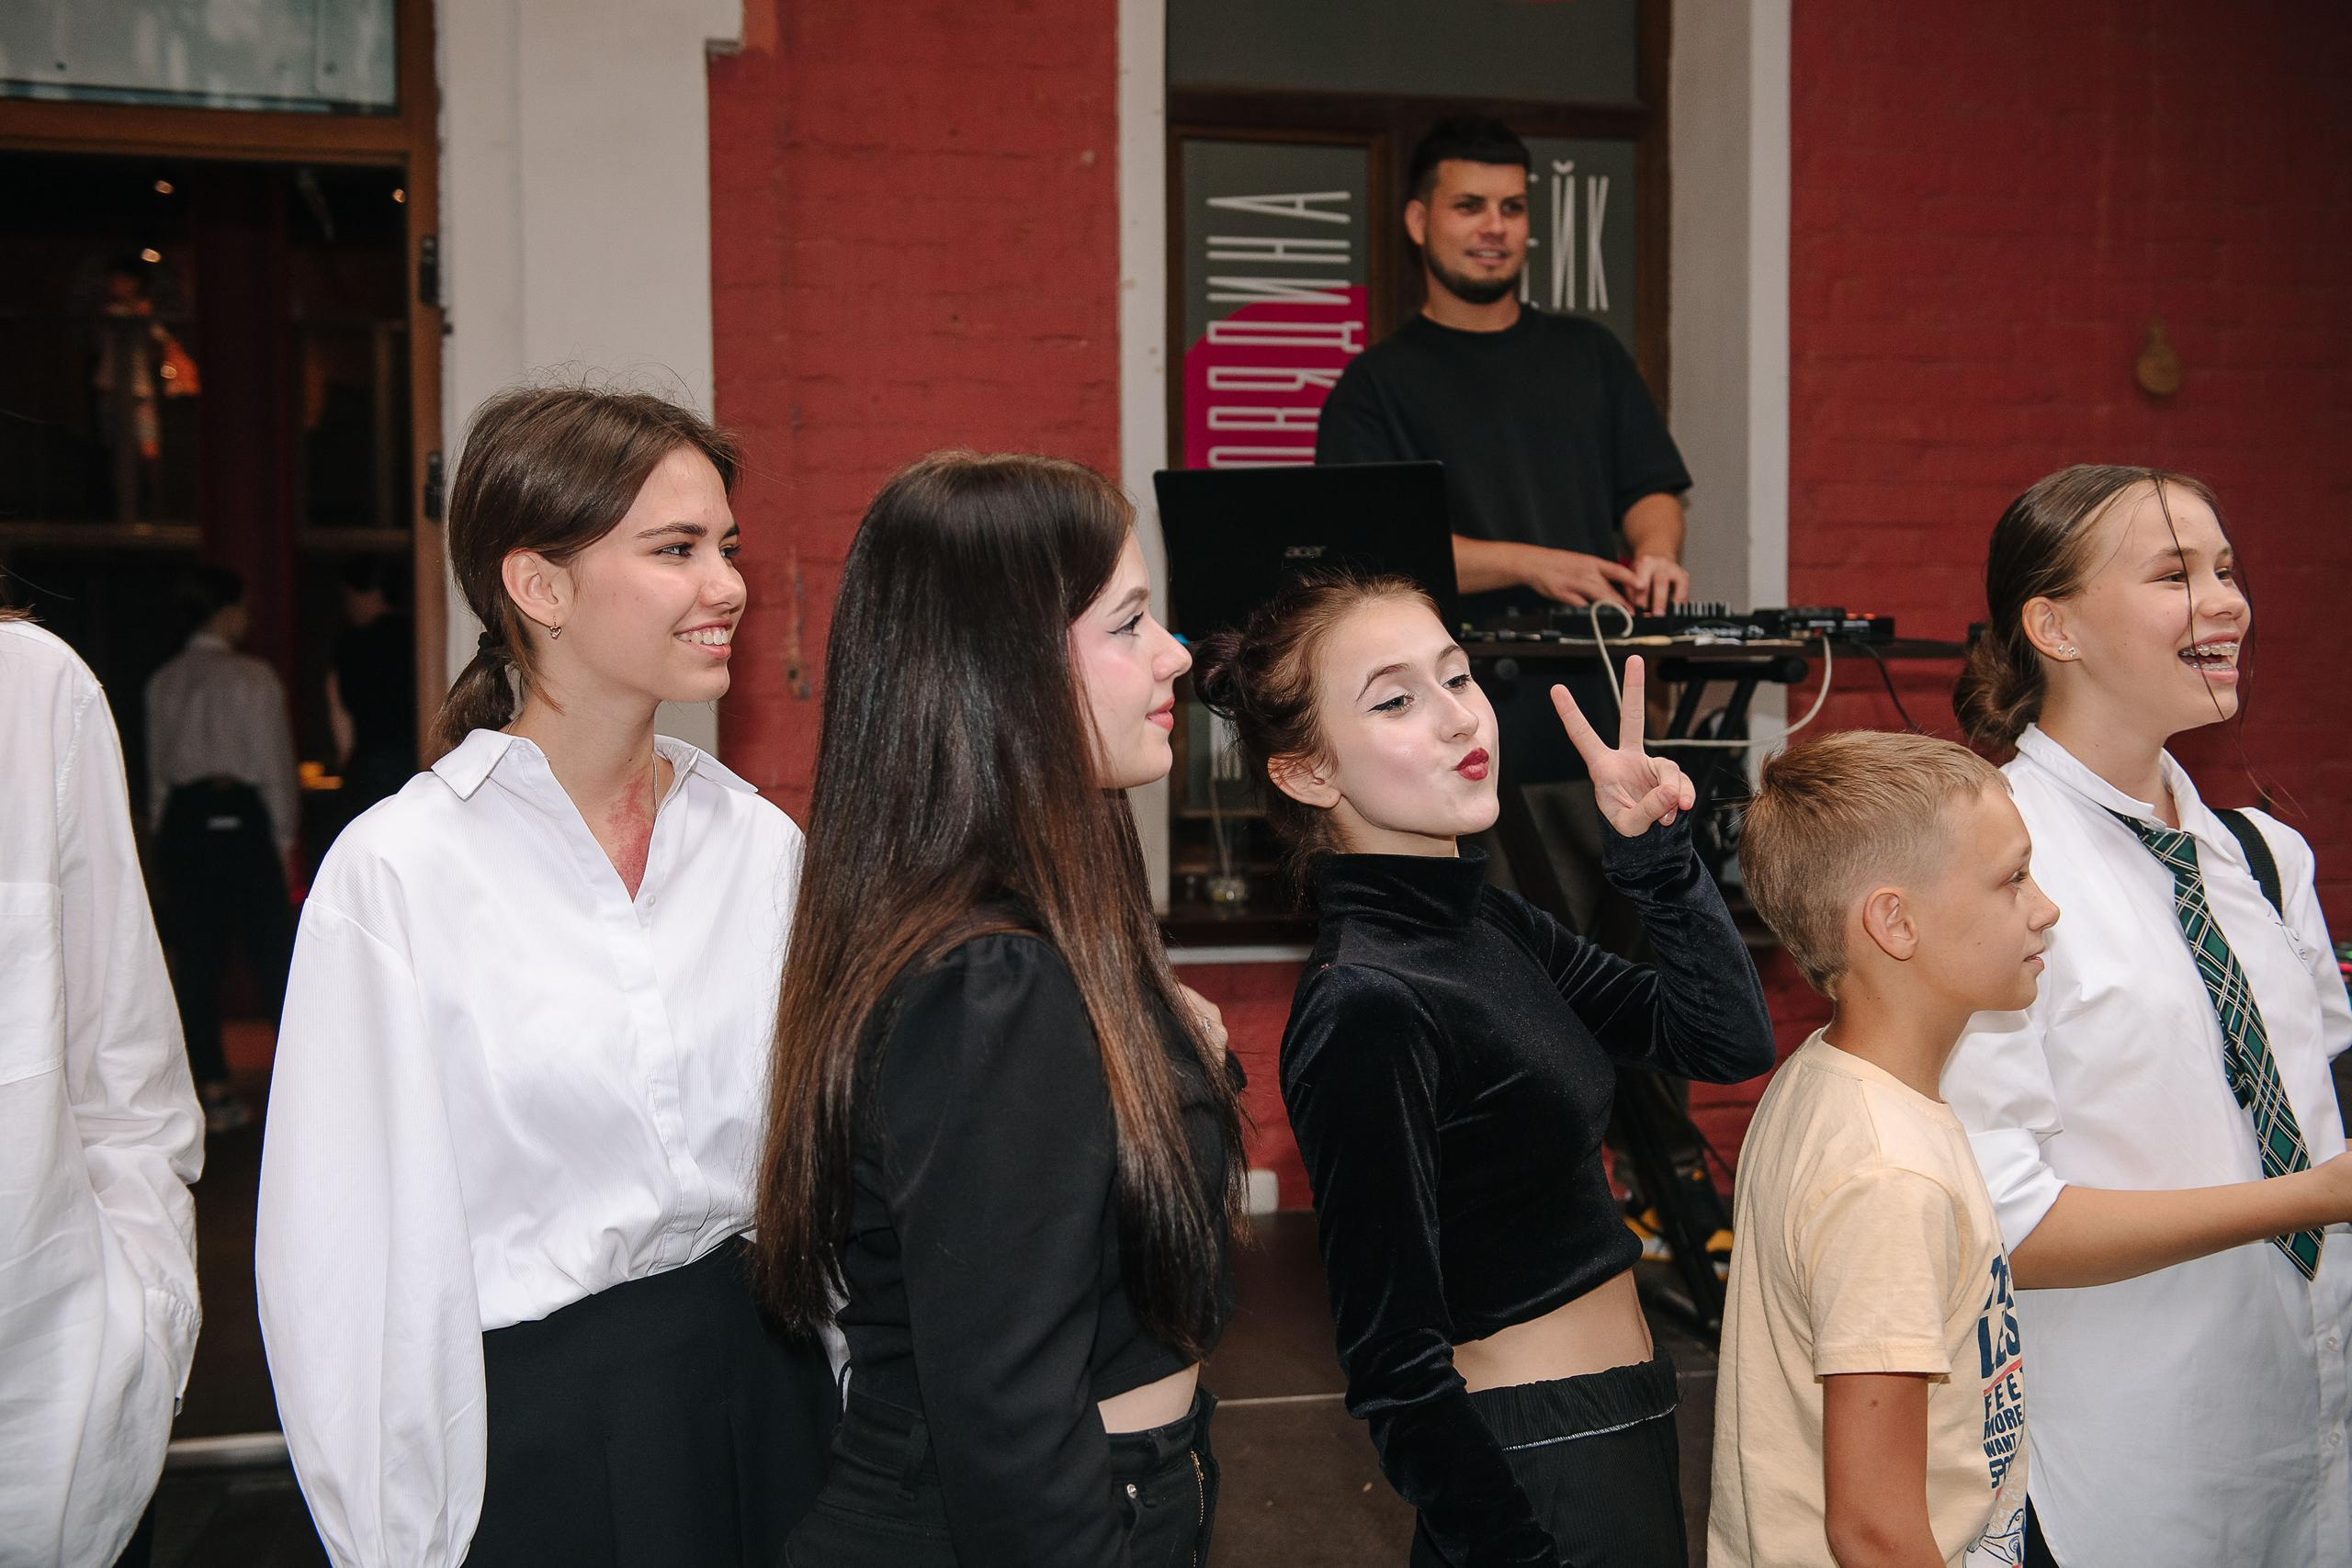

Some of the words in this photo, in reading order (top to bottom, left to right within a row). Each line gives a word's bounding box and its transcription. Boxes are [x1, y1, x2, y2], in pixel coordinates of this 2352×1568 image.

[1205, 190, 1365, 469] ОВЯДИНА
[1984, 1366, 2024, 1420] FEE
[1983, 1404, 2024, 1441] MORE
[1983, 1432, 2018, 1459] WANT
